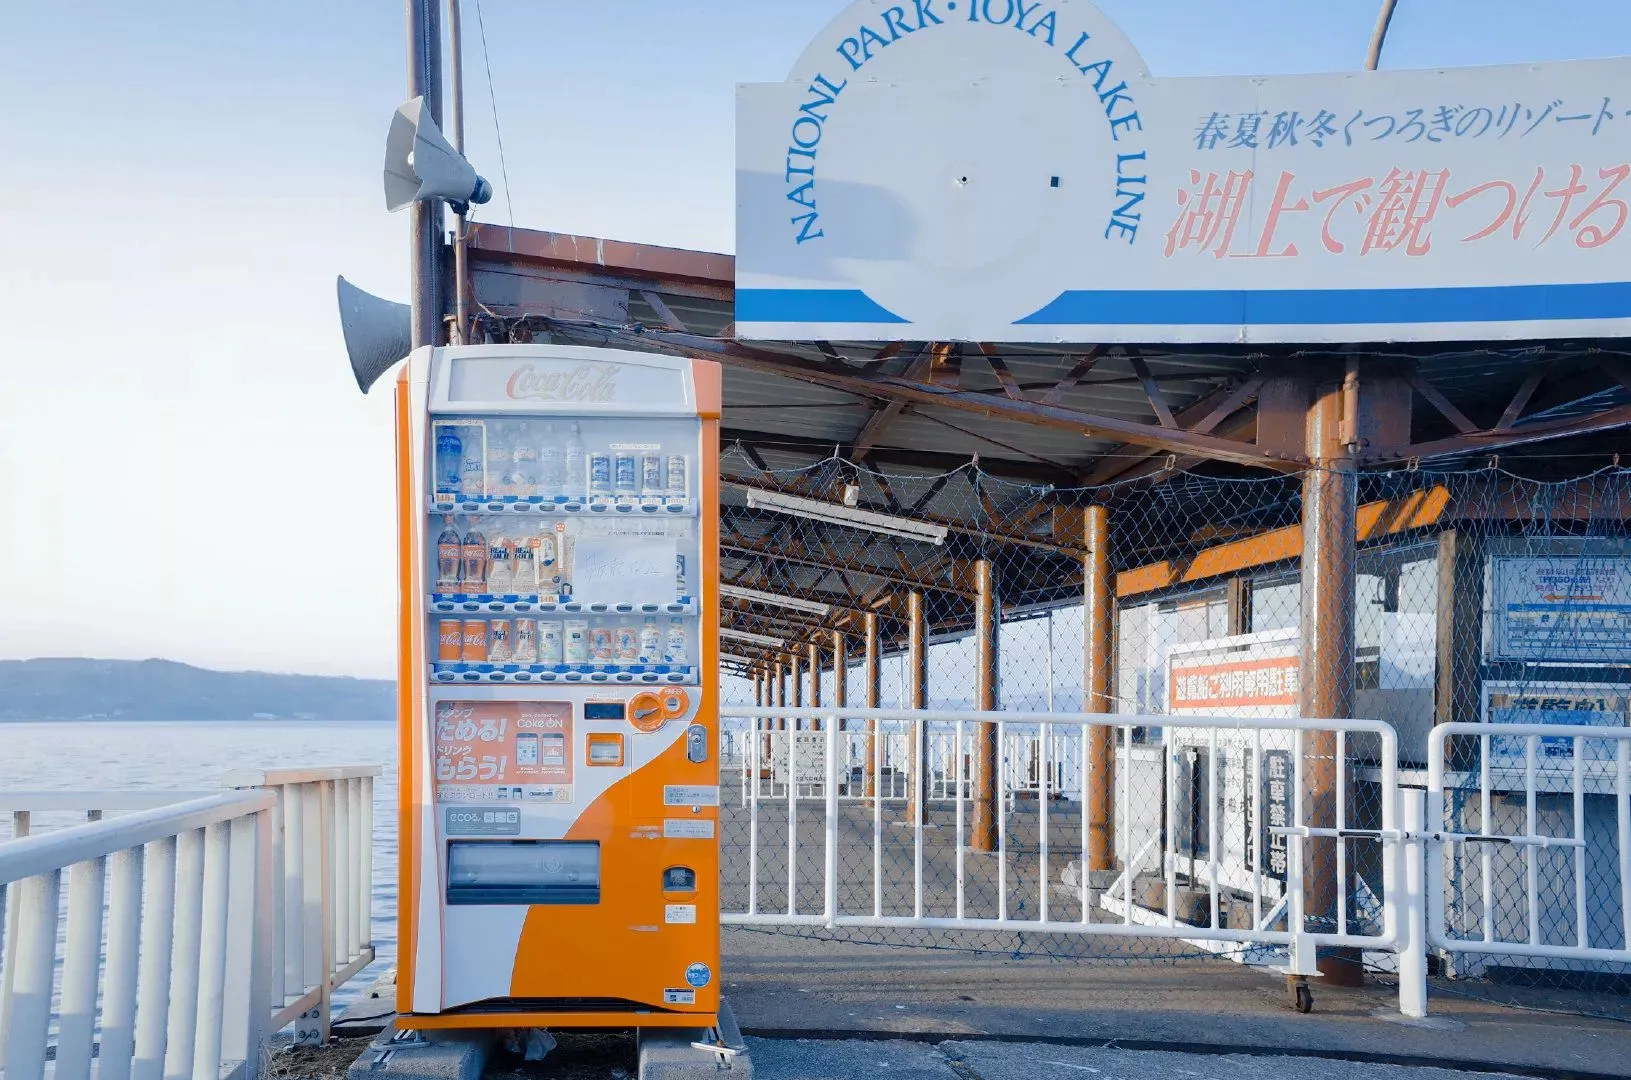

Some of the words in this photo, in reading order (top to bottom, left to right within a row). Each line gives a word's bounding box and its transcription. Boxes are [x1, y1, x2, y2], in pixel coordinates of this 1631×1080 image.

[786, 73, 847, 245] NATIONL
[836, 0, 944, 71] PARK
[1065, 31, 1143, 142] LAKE
[1104, 149, 1147, 245] LINE
[1193, 96, 1631, 150] 春夏秋冬くつろぎのリゾート
[1164, 164, 1631, 259] 湖上で観つける
[516, 718, 545, 728] Coke
